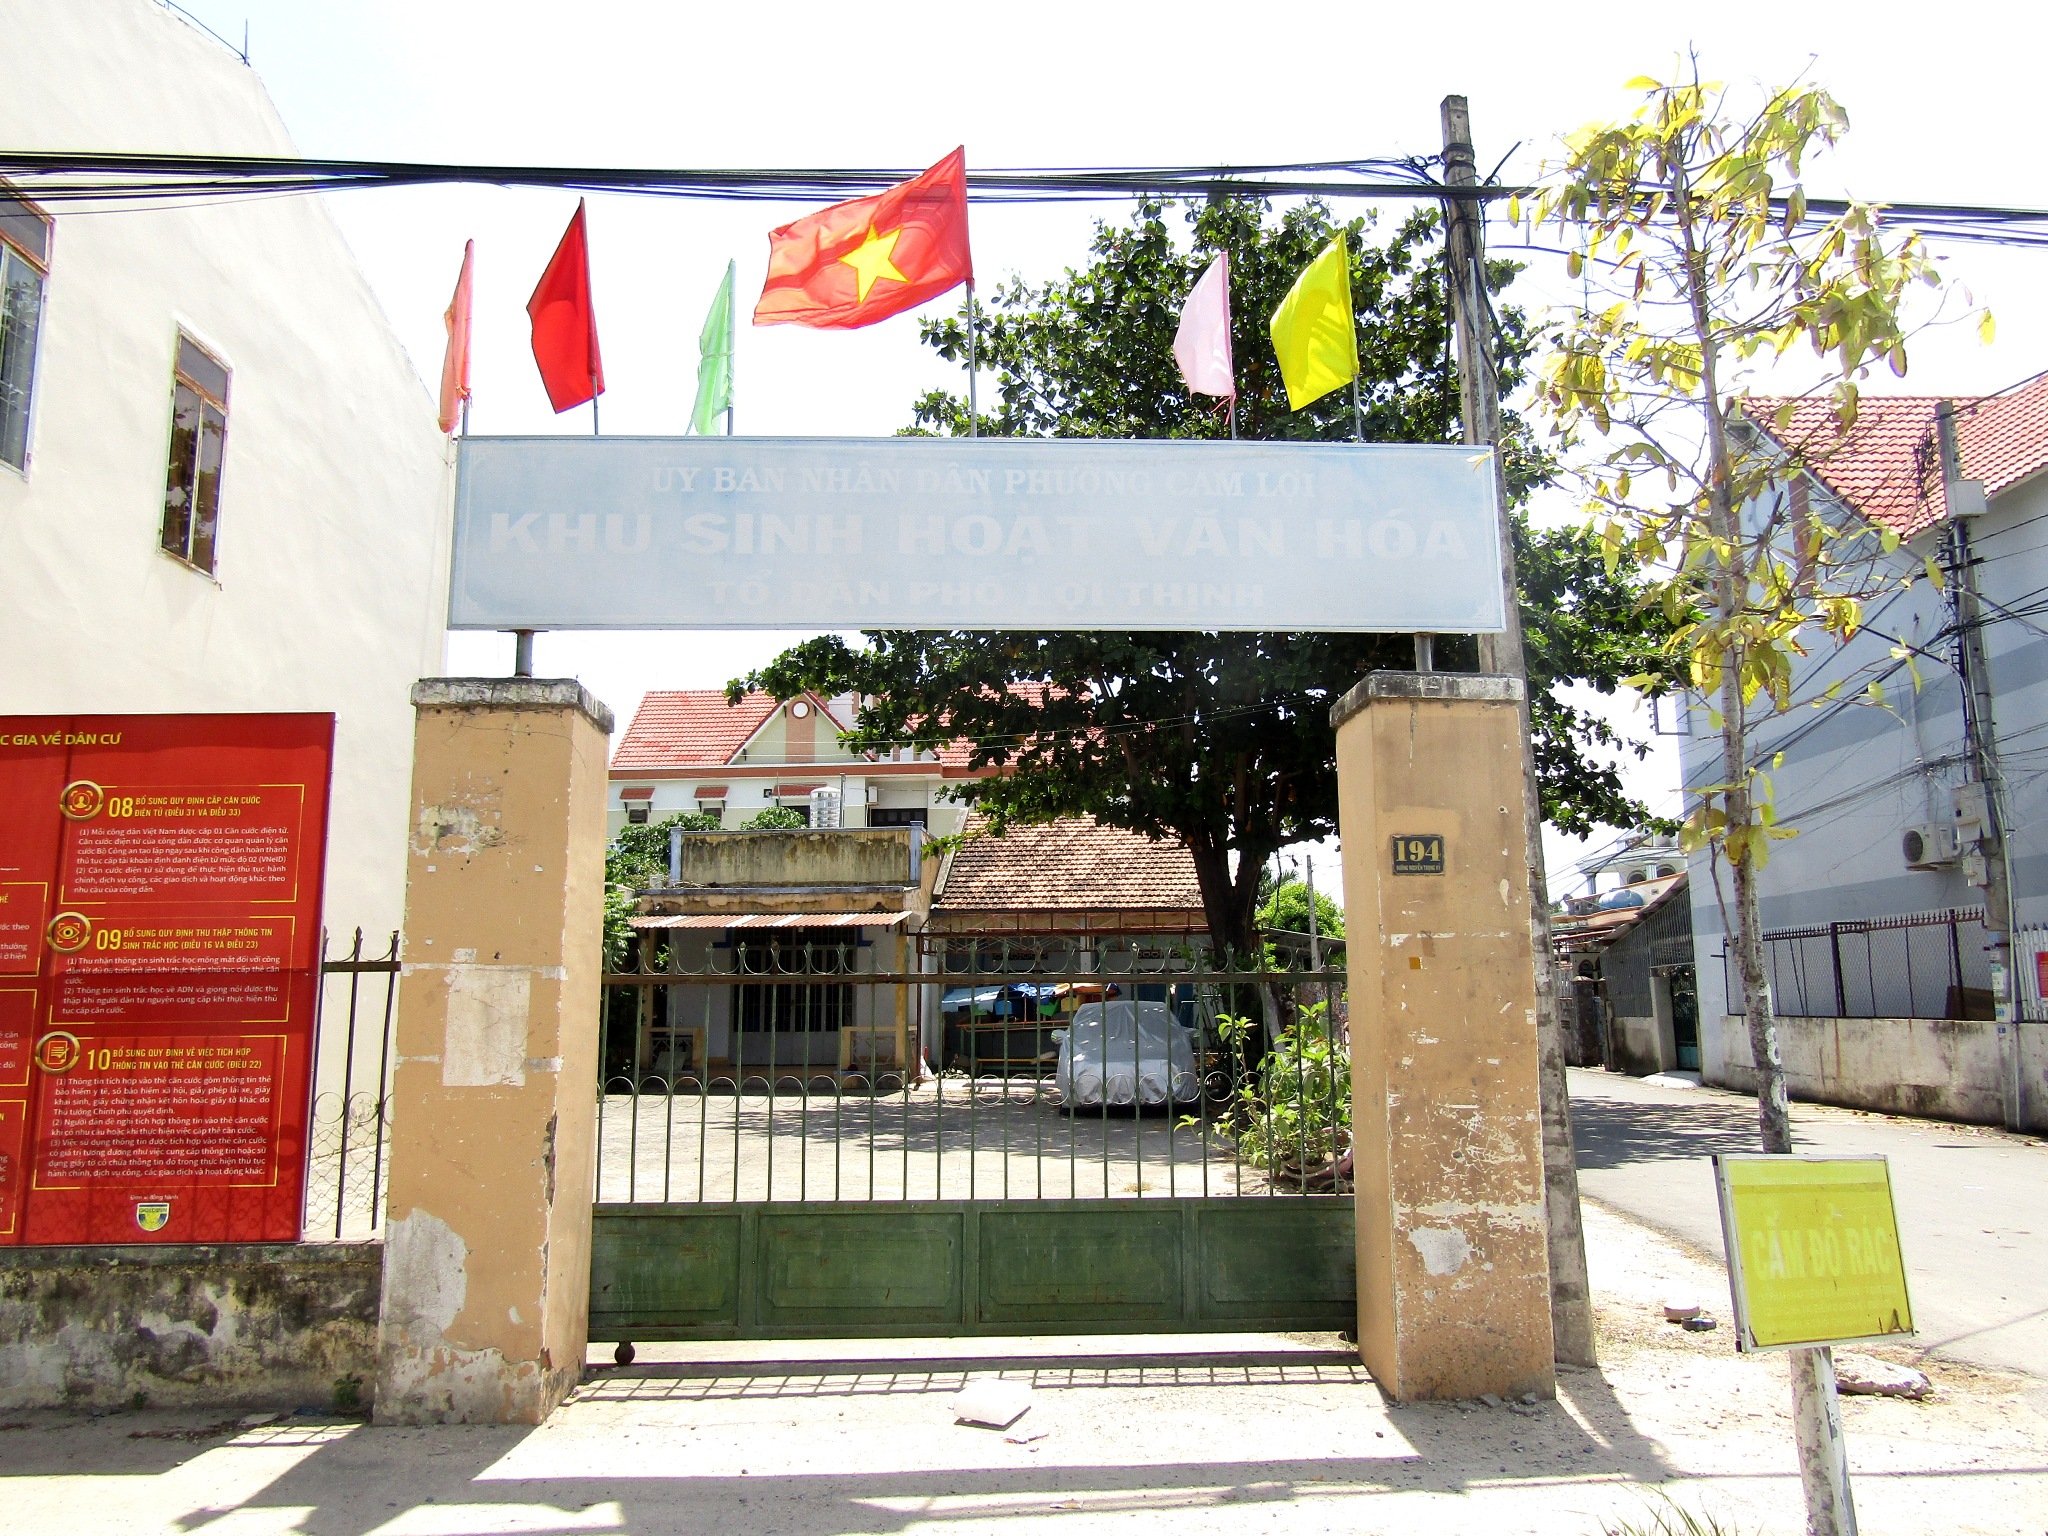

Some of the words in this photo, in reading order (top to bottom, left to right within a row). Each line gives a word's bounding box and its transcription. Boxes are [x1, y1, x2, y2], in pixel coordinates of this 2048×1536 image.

[713, 466, 787, 493] BAN
[801, 461, 902, 494] NHÂN
[915, 462, 993, 495] DÂN
[1004, 465, 1153, 497] PHƯỜNG
[1165, 469, 1244, 498] CAM
[1257, 469, 1317, 500] LỢI
[490, 512, 651, 554] KHU
[681, 512, 863, 555] SINH
[899, 514, 1103, 563] HOẠT
[1134, 508, 1286, 558] VĂN
[1315, 508, 1469, 560] HÓA
[790, 576, 892, 605] DÂN
[1119, 581, 1265, 612] THỊNH
[13, 734, 38, 745] GIA
[64, 731, 97, 745] DÂN
[100, 732, 122, 745] CƯ
[108, 797, 133, 818] 08
[1396, 840, 1441, 862] 194
[96, 929, 121, 950] 09
[87, 1049, 111, 1071] 10
